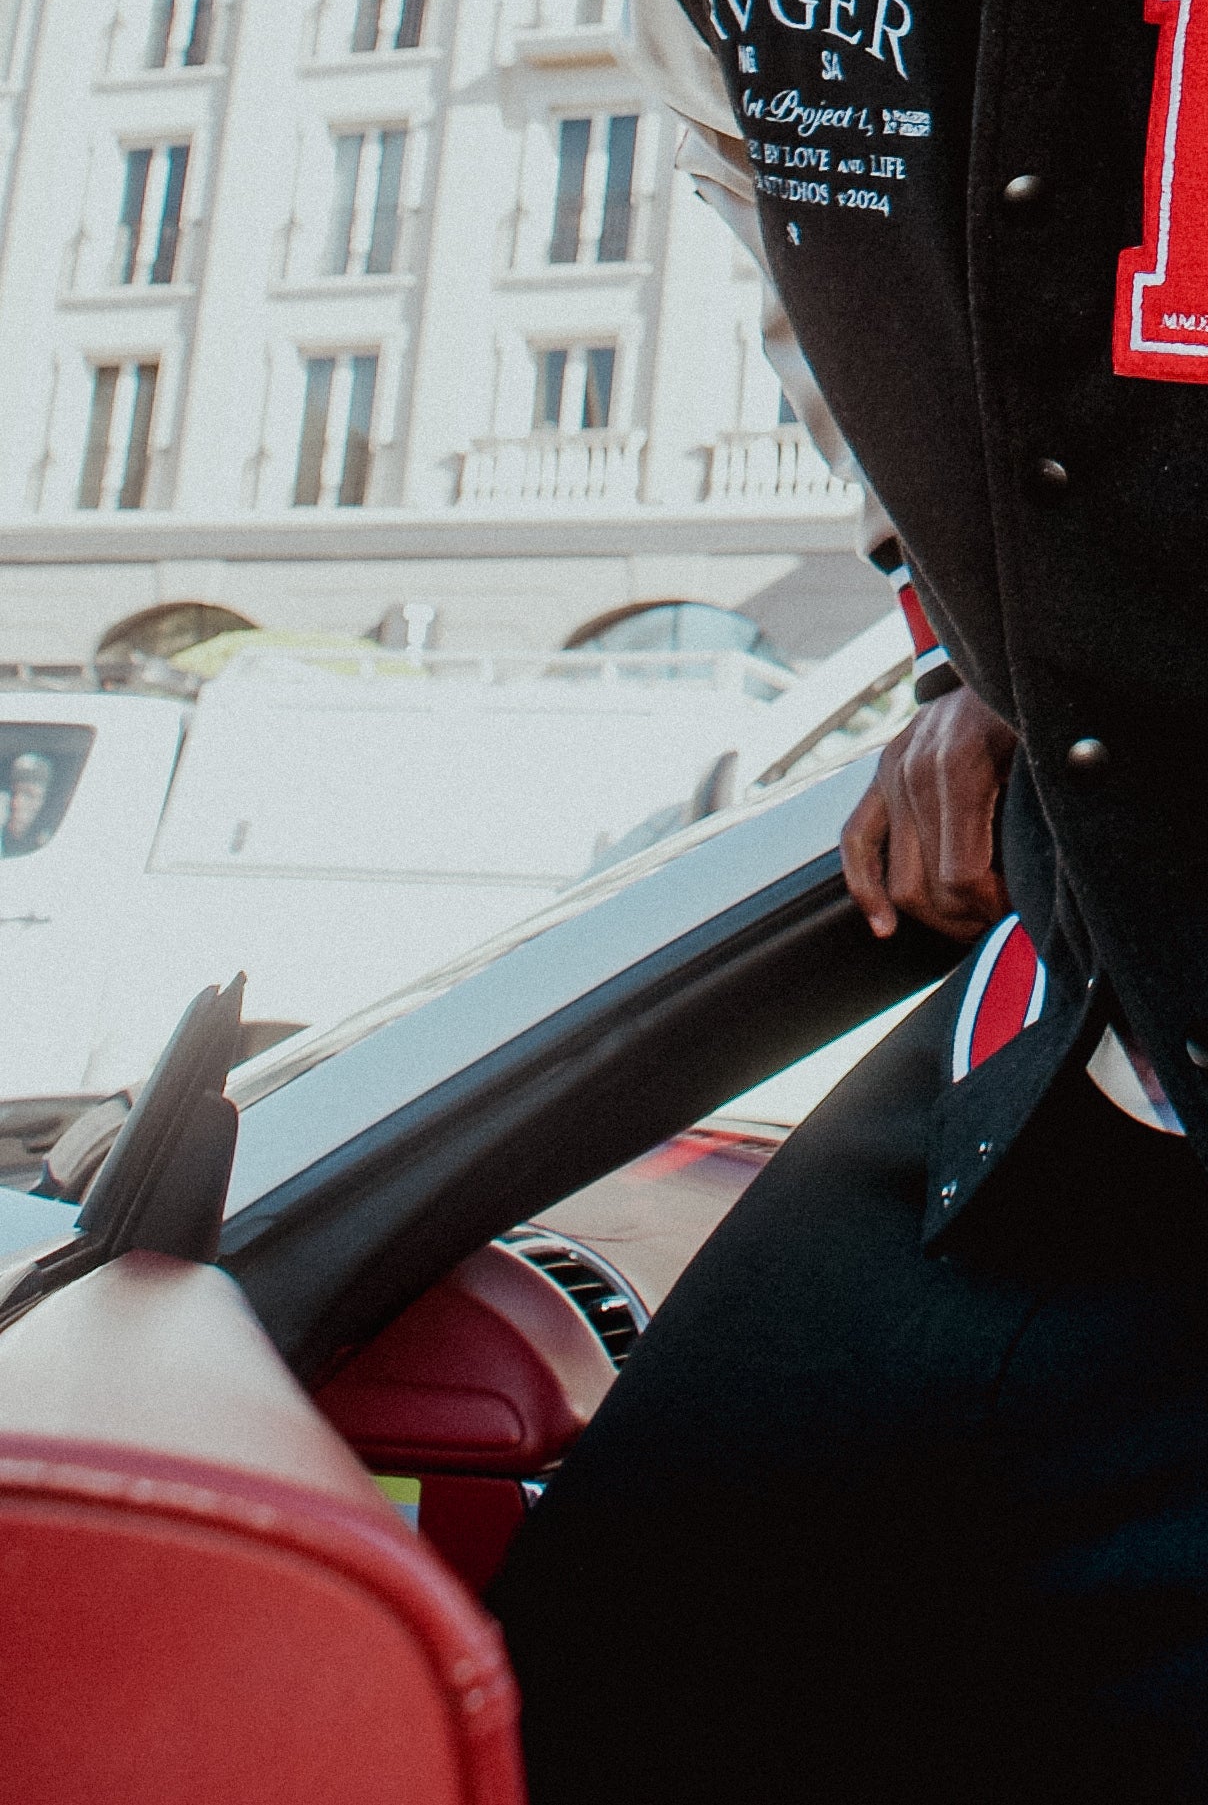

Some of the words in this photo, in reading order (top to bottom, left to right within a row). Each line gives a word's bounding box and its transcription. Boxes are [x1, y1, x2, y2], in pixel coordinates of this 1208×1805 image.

[765, 89, 854, 137] Project
[782, 146, 831, 171] LOVE
[869, 155, 907, 180] LIFE
